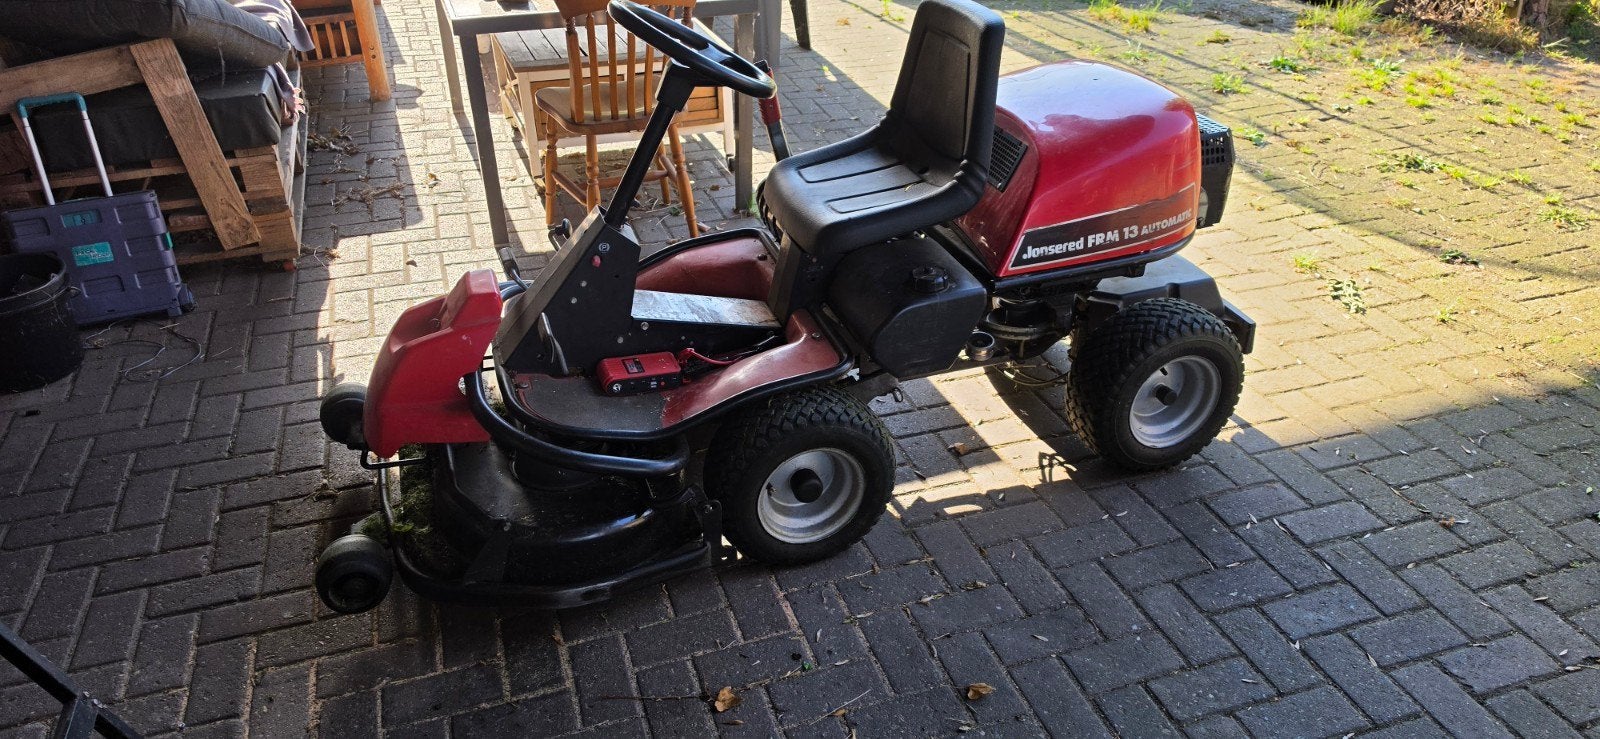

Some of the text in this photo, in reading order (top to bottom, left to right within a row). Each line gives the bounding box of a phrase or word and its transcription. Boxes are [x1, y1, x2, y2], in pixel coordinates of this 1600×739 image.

[1022, 208, 1192, 260] Jonsered FRM 13 AUTOMATIC
